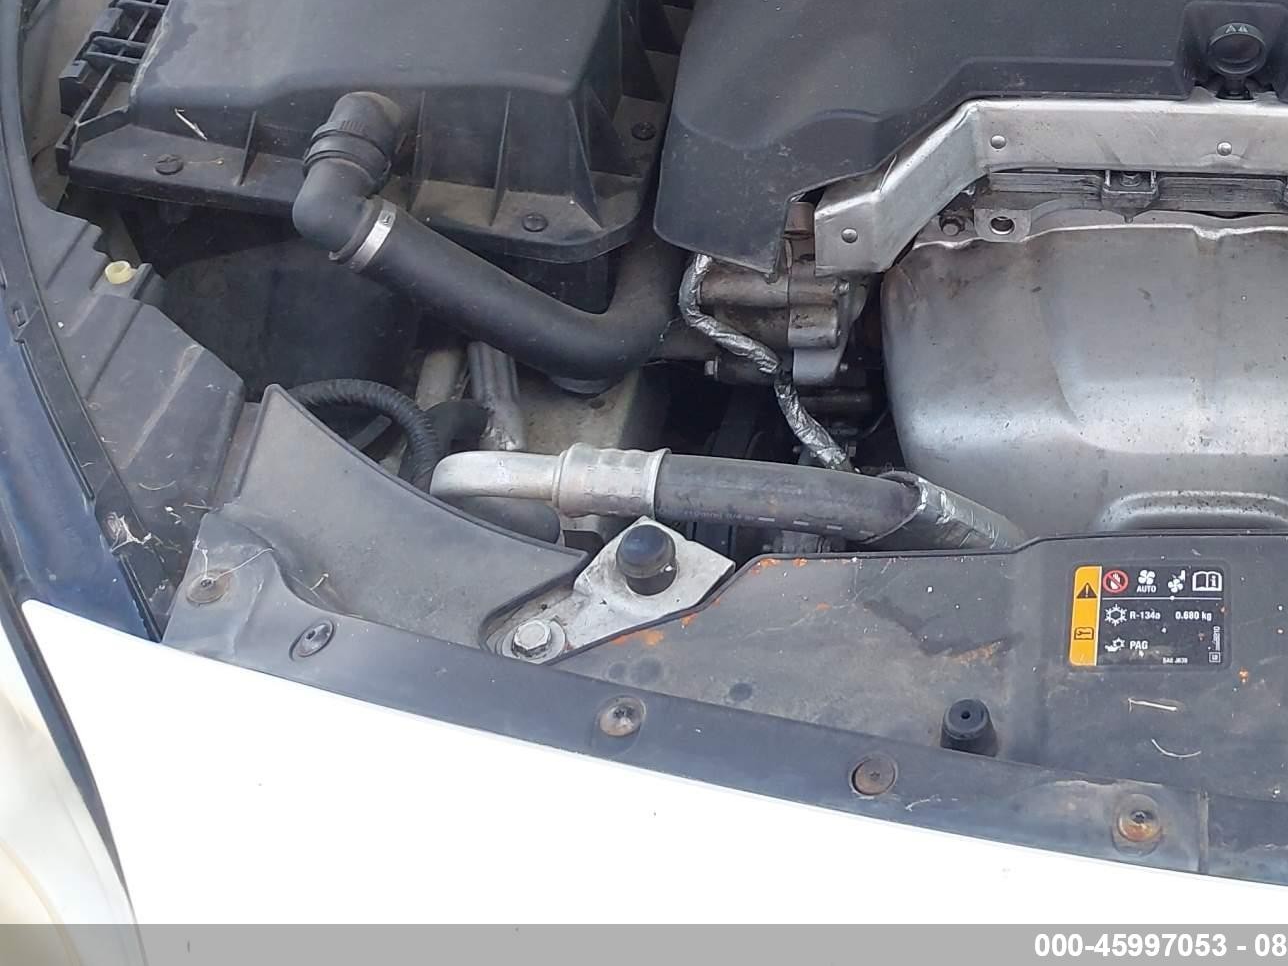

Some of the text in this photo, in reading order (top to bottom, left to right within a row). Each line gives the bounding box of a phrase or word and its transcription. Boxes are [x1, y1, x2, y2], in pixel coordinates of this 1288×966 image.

[1136, 585, 1157, 593] AUTO
[1129, 611, 1161, 620] R-134a
[1201, 610, 1212, 621] kg
[1129, 640, 1149, 650] PAG
